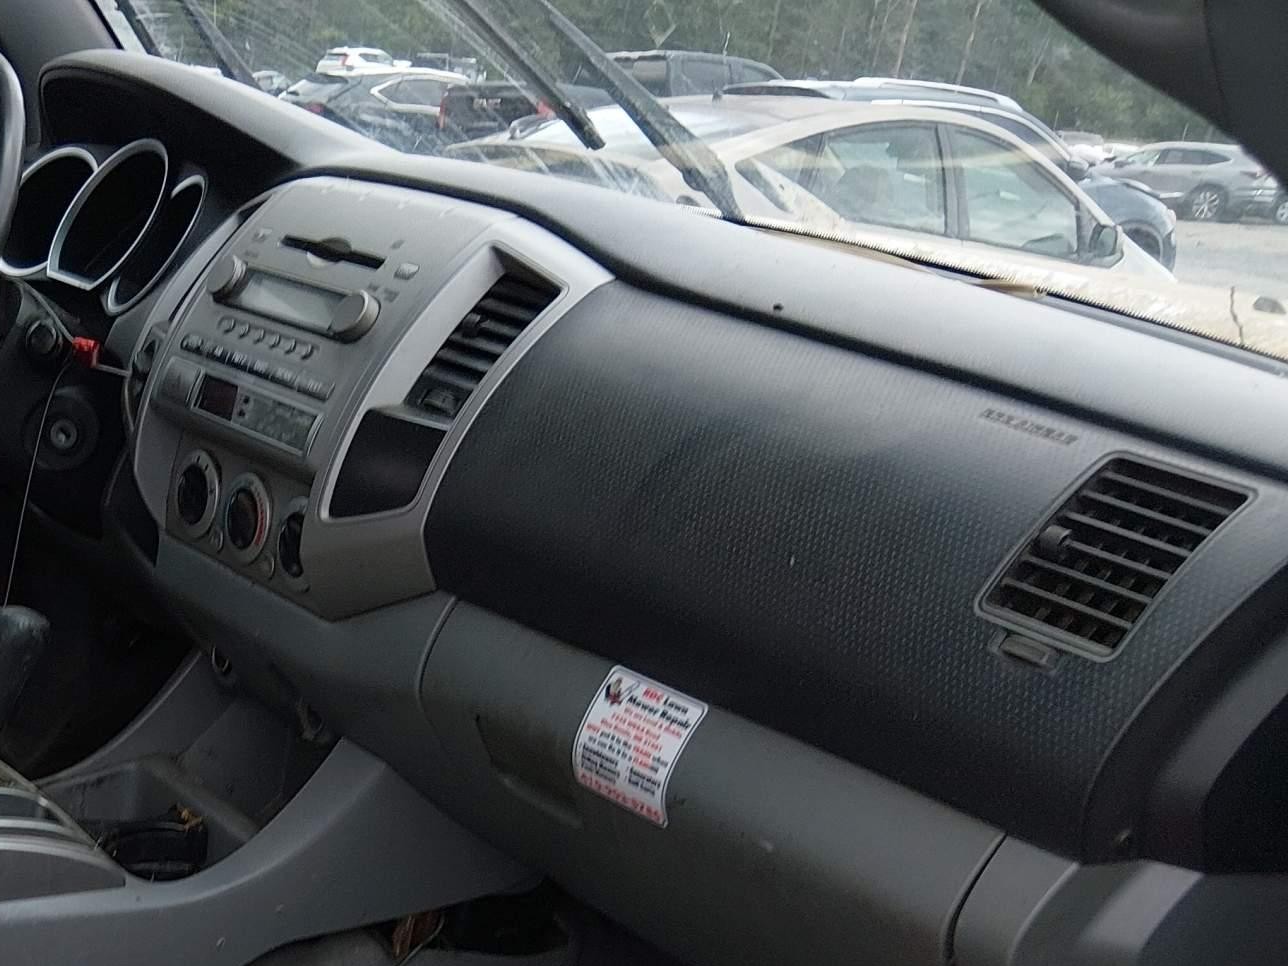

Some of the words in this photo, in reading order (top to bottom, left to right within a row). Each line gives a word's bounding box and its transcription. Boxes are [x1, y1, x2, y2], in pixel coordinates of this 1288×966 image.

[627, 694, 659, 716] Mower
[660, 708, 692, 731] Repair
[663, 696, 689, 715] Lawn
